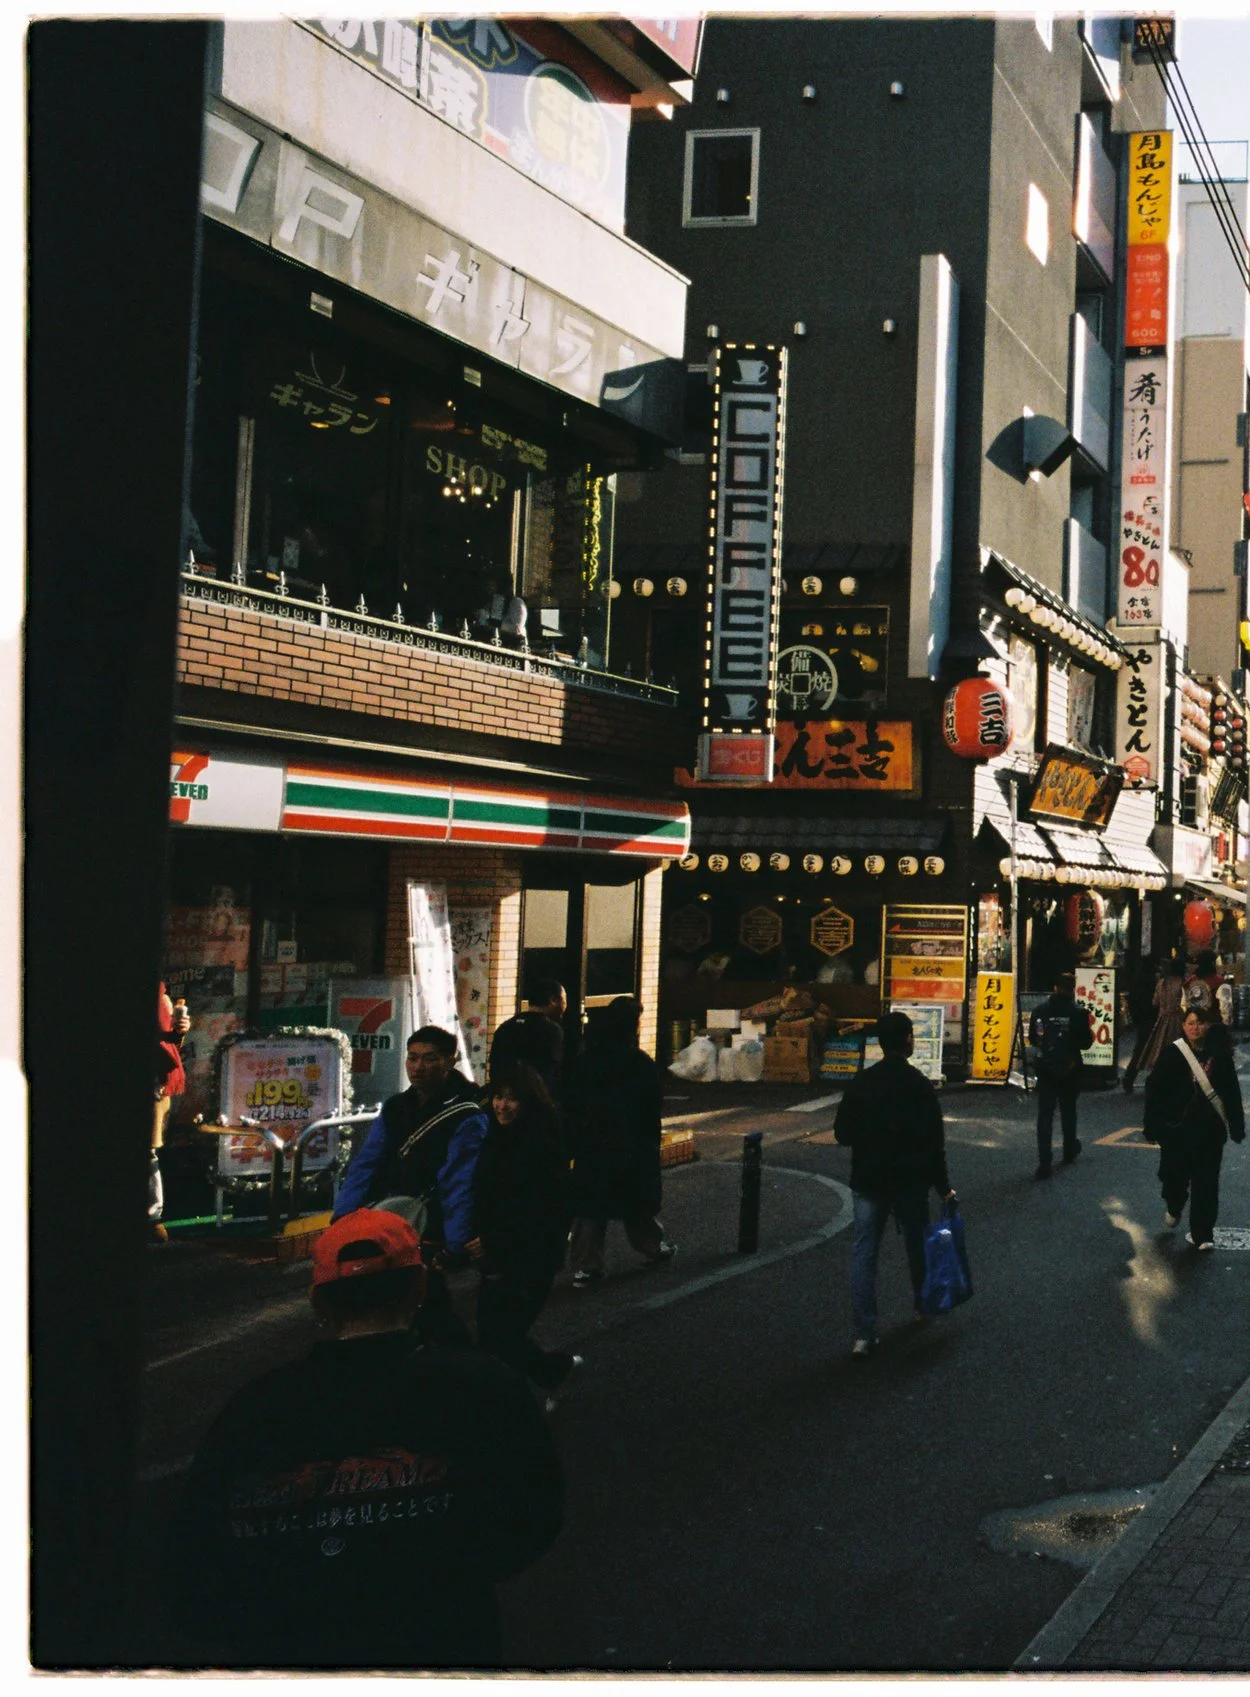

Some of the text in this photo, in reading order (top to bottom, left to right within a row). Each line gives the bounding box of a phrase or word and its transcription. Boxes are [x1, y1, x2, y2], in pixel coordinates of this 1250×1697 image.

[1136, 134, 1165, 227] 月島もんじゃ
[270, 383, 381, 435] ギャラン
[1129, 372, 1162, 406] 肴
[1137, 408, 1155, 461] うたげ
[426, 445, 509, 498] SHOP
[720, 400, 771, 679] COFFEE
[1123, 527, 1159, 550] やきとん
[979, 691, 1005, 747] 三吉
[1124, 648, 1152, 753] やきとん
[775, 724, 895, 780] ん三吉
[982, 978, 1003, 1066] 月島もんじゃ
